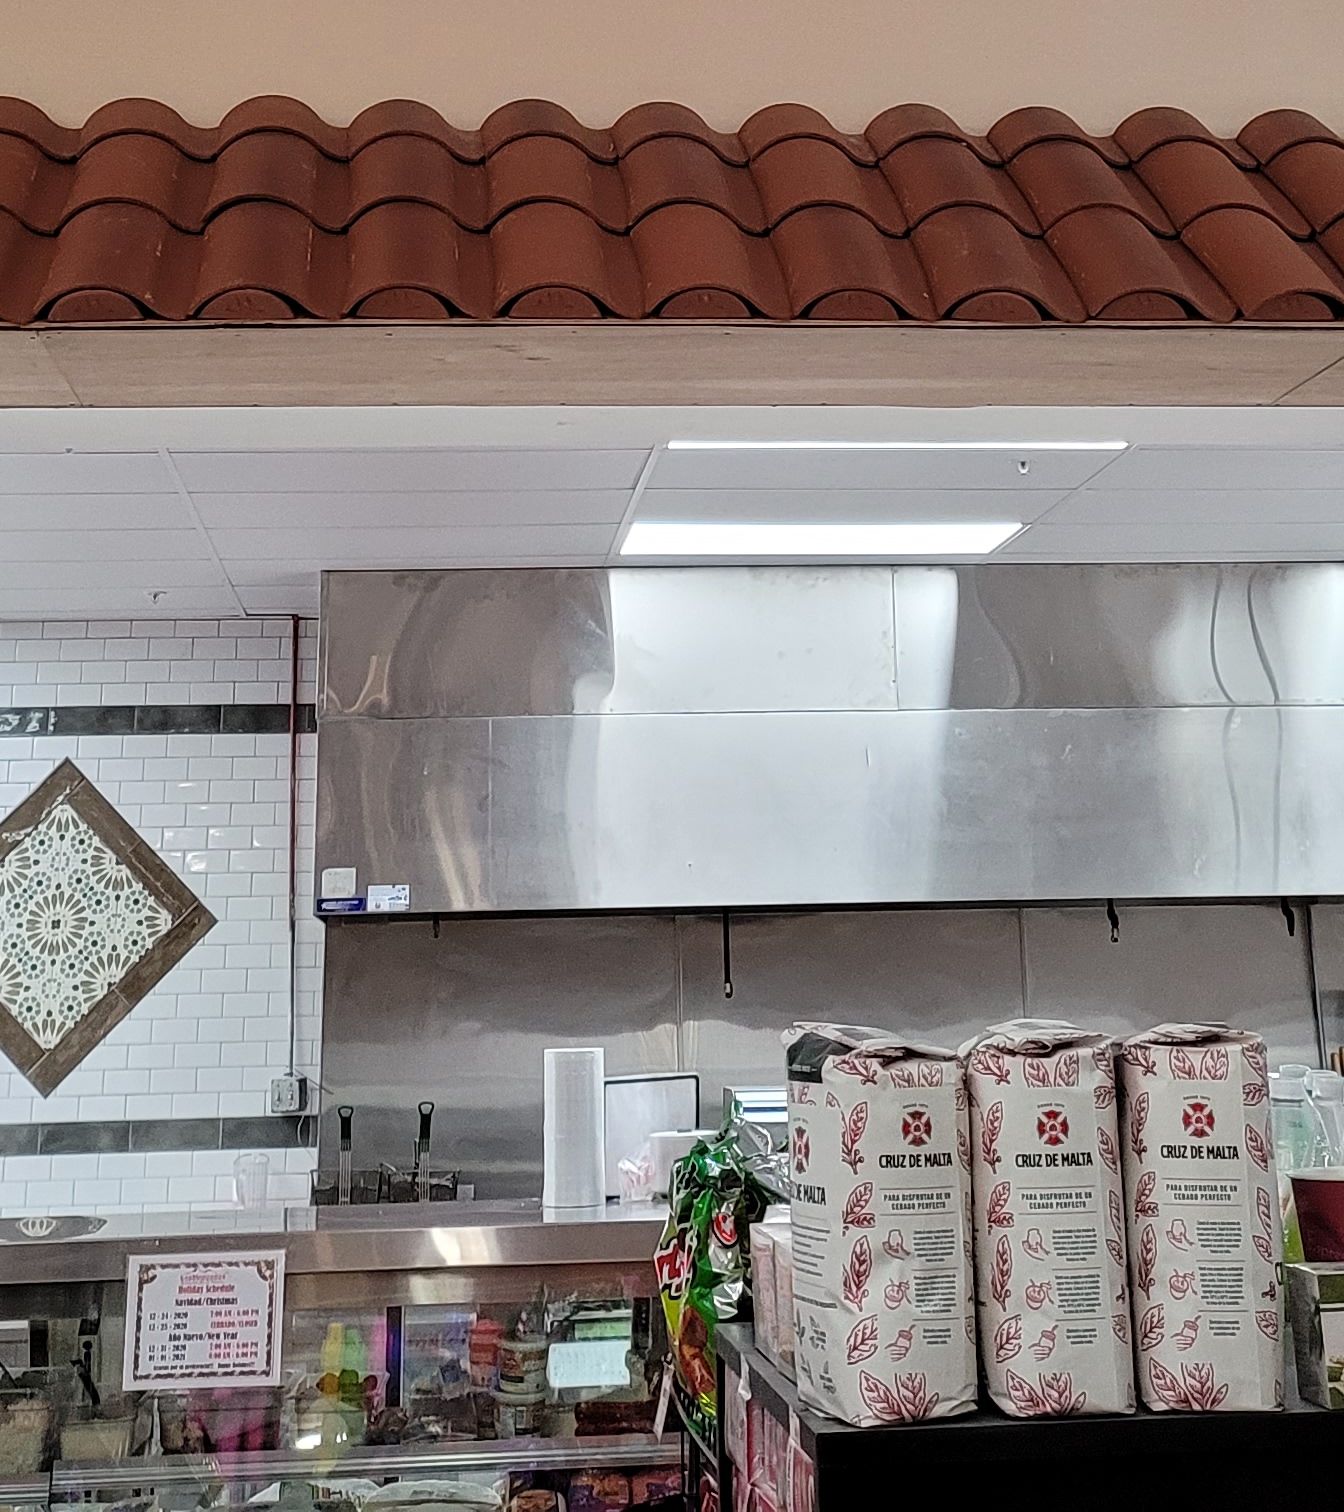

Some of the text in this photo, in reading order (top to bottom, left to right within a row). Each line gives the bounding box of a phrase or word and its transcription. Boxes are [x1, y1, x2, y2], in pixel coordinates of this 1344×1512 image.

[1015, 1151, 1094, 1169] CRUZ DE MALTA
[1160, 1144, 1240, 1160] CRUZ DE MALTA
[878, 1152, 953, 1169] CRUZ DE MALTA
[803, 1184, 827, 1206] MALTA
[883, 1192, 900, 1202] PARA
[1021, 1191, 1038, 1201] PARA
